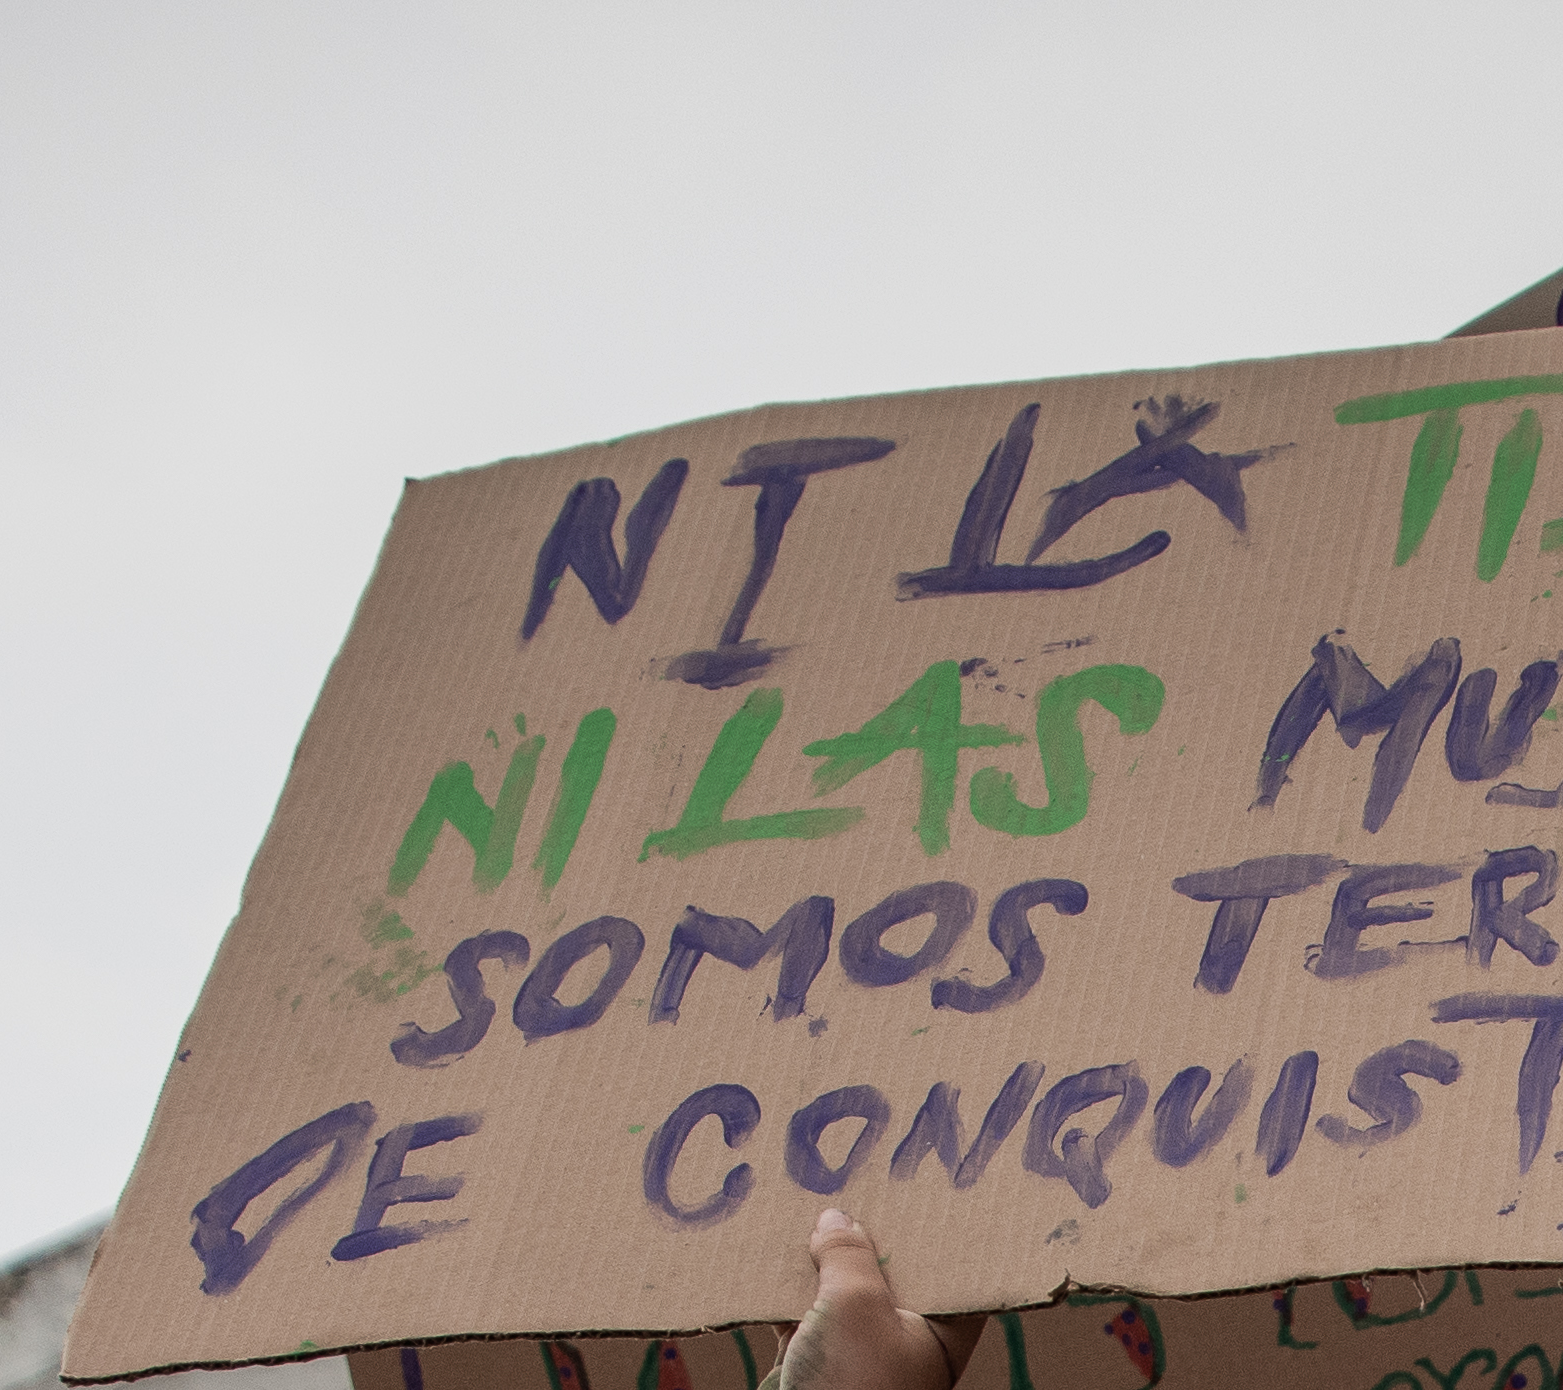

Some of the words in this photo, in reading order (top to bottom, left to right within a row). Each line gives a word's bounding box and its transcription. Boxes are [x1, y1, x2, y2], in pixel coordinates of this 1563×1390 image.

[517, 436, 897, 691] NI
[896, 393, 1295, 601] LA
[386, 708, 617, 899] NI
[637, 661, 1166, 860] LAS
[392, 878, 1090, 1067] SOMOS
[190, 1100, 485, 1296] DE
